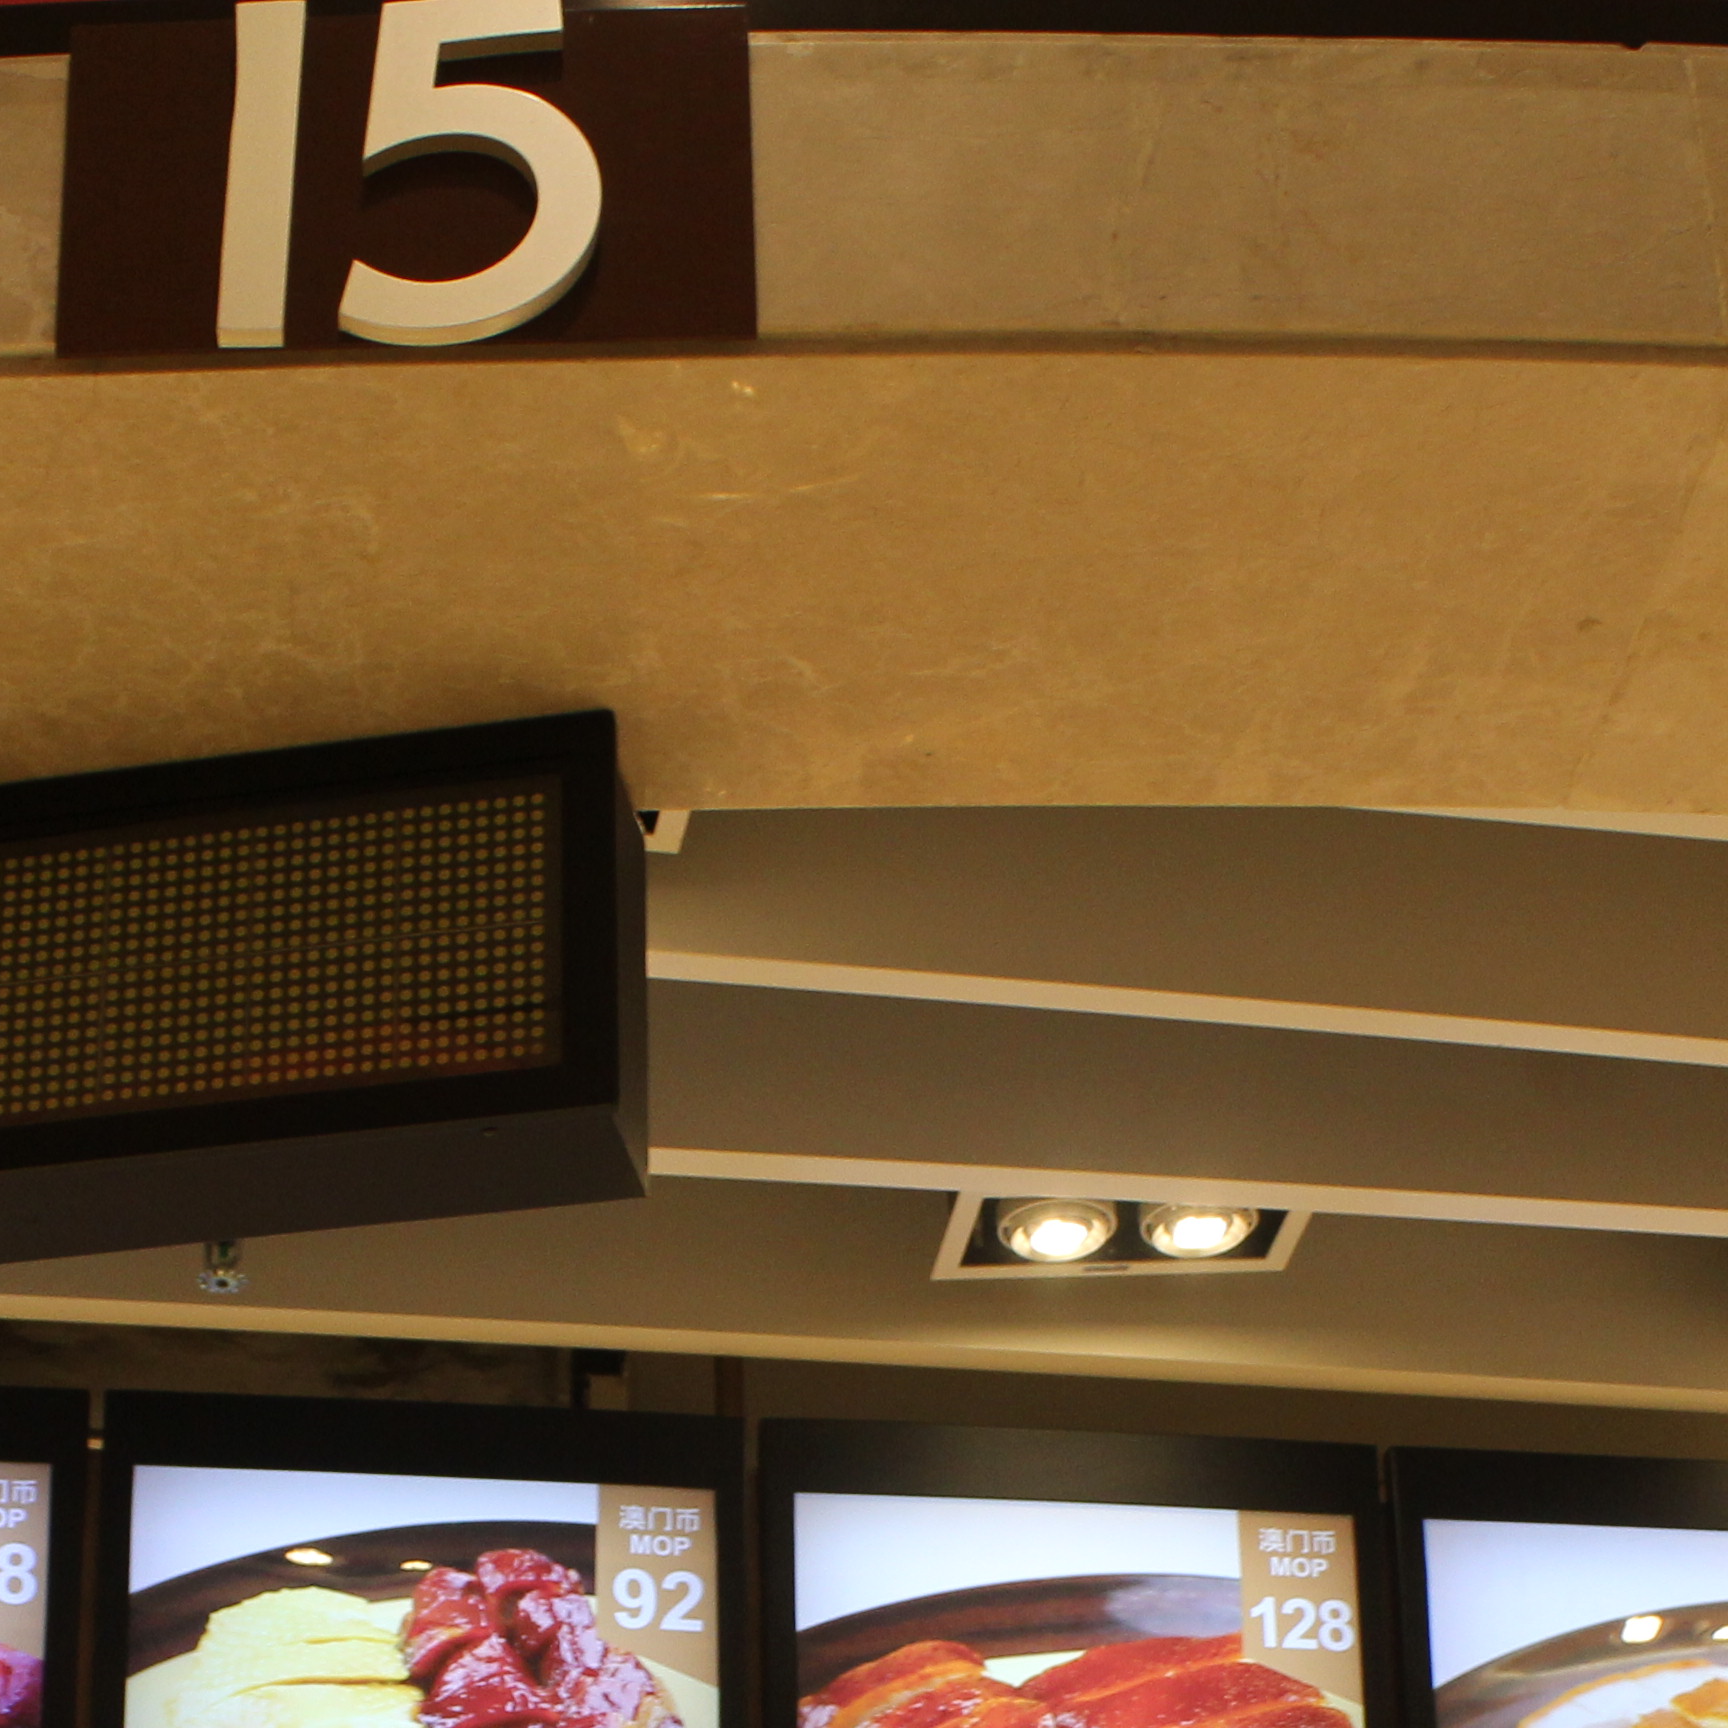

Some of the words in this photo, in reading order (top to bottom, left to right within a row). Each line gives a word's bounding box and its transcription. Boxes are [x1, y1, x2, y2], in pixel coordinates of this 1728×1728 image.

[216, 0, 602, 347] 15
[629, 1533, 692, 1556] MOP
[1269, 1556, 1329, 1578] MOP
[612, 1567, 705, 1633] 92
[1249, 1595, 1356, 1653] 128
